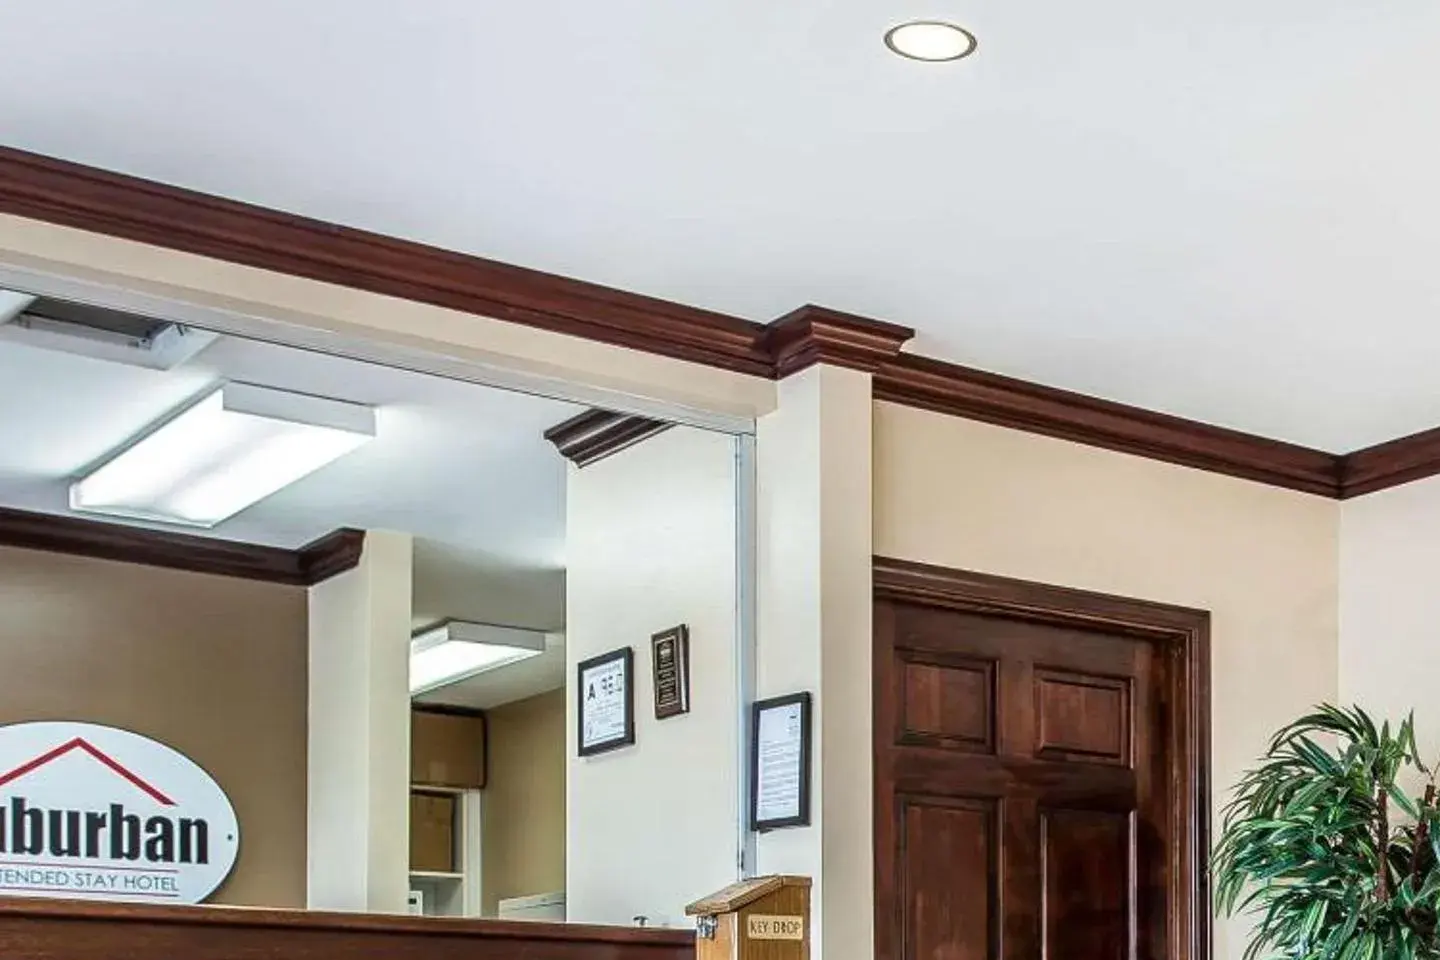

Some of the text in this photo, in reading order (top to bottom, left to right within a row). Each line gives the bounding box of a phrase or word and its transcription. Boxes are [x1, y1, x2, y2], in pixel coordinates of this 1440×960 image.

[0, 796, 209, 865] burban
[74, 872, 118, 888] STAY
[124, 875, 180, 892] HOTEL
[750, 919, 801, 935] KEY DROP
